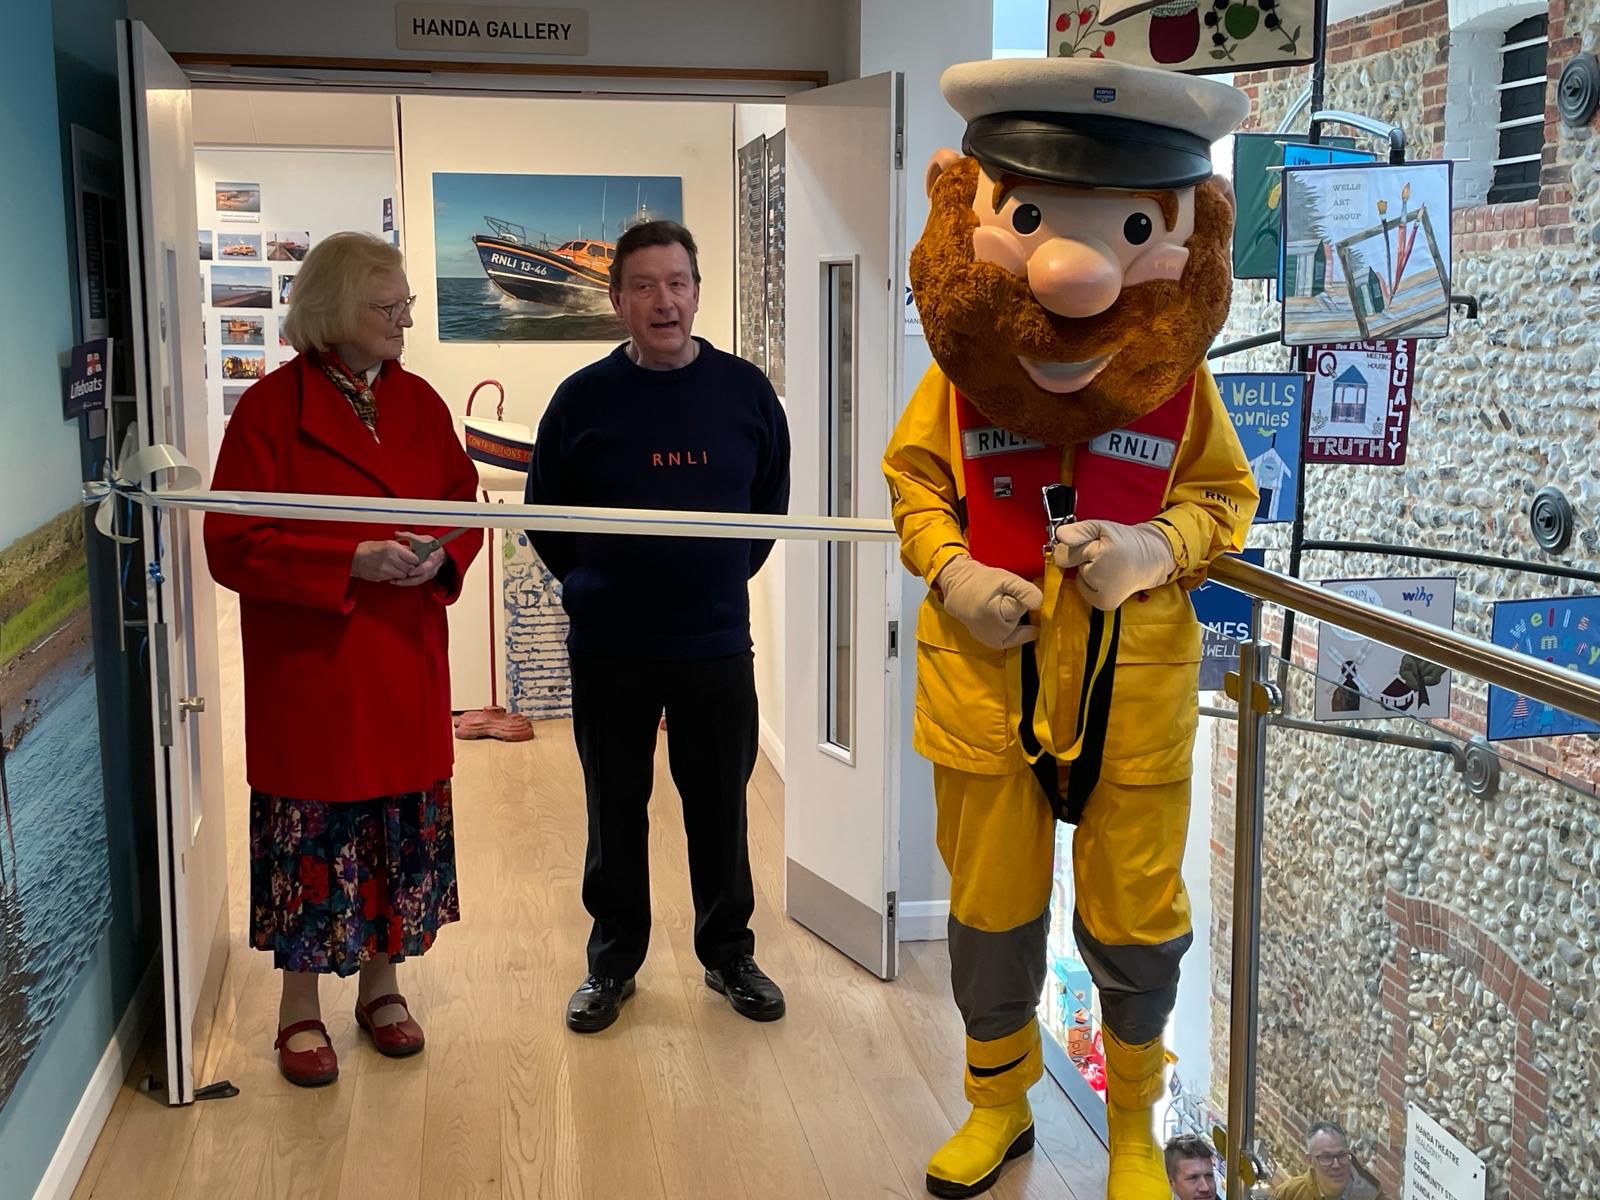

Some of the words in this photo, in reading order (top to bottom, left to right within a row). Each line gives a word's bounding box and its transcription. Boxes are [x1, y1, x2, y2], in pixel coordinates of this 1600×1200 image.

[412, 18, 480, 37] HANDA
[486, 21, 572, 41] GALLERY
[1333, 213, 1361, 221] GROUP
[491, 253, 518, 268] RNLI
[521, 261, 547, 276] 13-46
[1366, 352, 1392, 360] MEETING
[70, 377, 103, 400] Lifeboats
[468, 435, 522, 459] CONTRIBUTIONS
[979, 429, 1027, 451] RNL
[1108, 433, 1160, 461] RNLI
[1308, 438, 1385, 458] TRUTH
[652, 451, 708, 467] RNLI
[1205, 491, 1238, 513] RNLI
[1202, 622, 1250, 641] MES
[1415, 1122, 1434, 1145] HANDA
[1435, 1138, 1460, 1167] THEATRE
[1414, 1150, 1430, 1171] CLORE
[1413, 1162, 1444, 1194] COMMUNITY
[1412, 1179, 1430, 1200] HANDA
